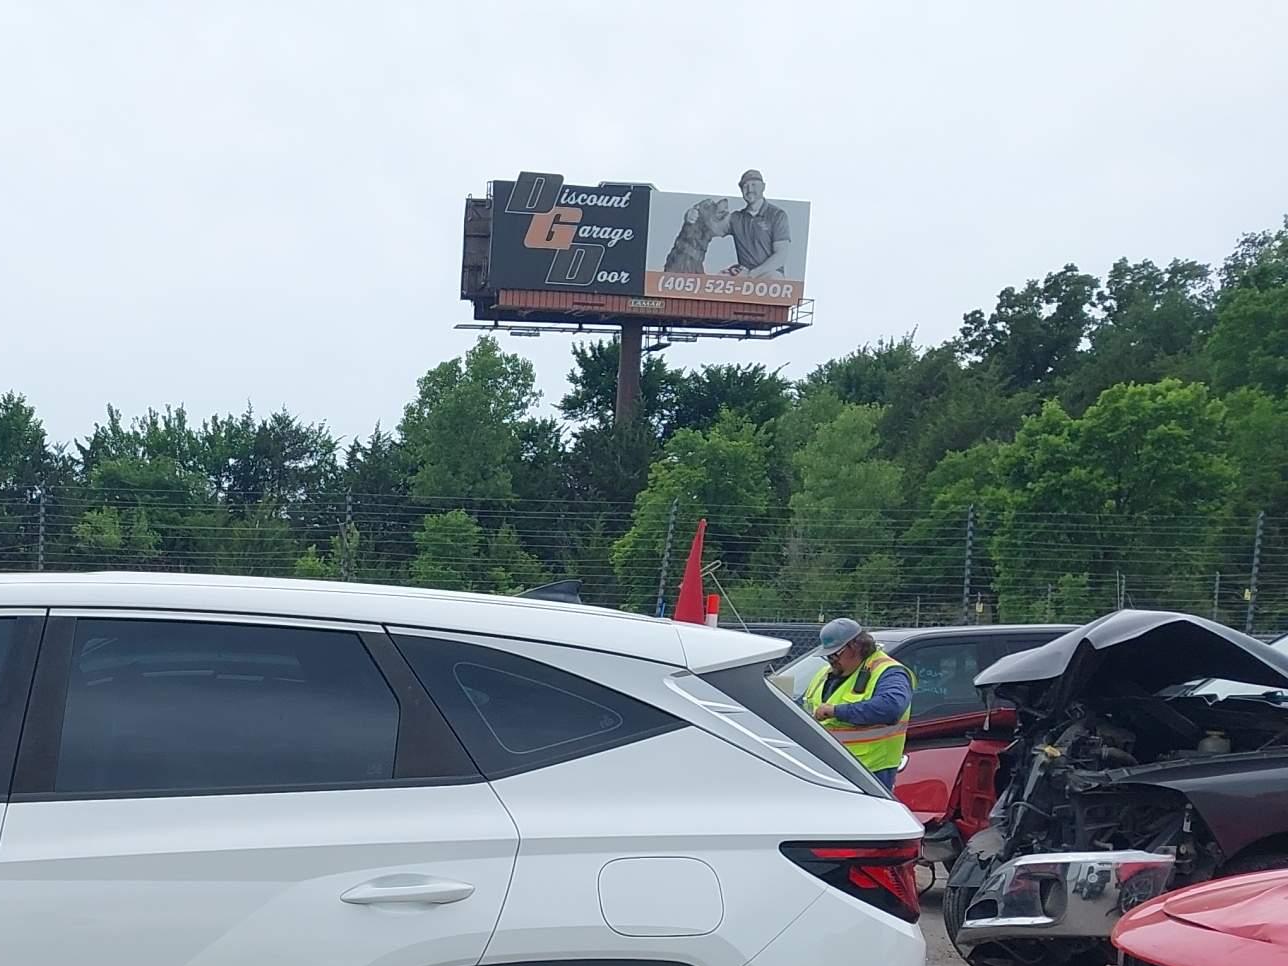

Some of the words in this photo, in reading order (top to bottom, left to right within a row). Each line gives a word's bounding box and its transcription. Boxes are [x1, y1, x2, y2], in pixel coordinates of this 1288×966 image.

[505, 171, 632, 215] Discount
[523, 206, 634, 250] Garage
[545, 242, 631, 286] Door
[657, 277, 701, 294] (405)
[704, 279, 794, 298] 525-DOOR
